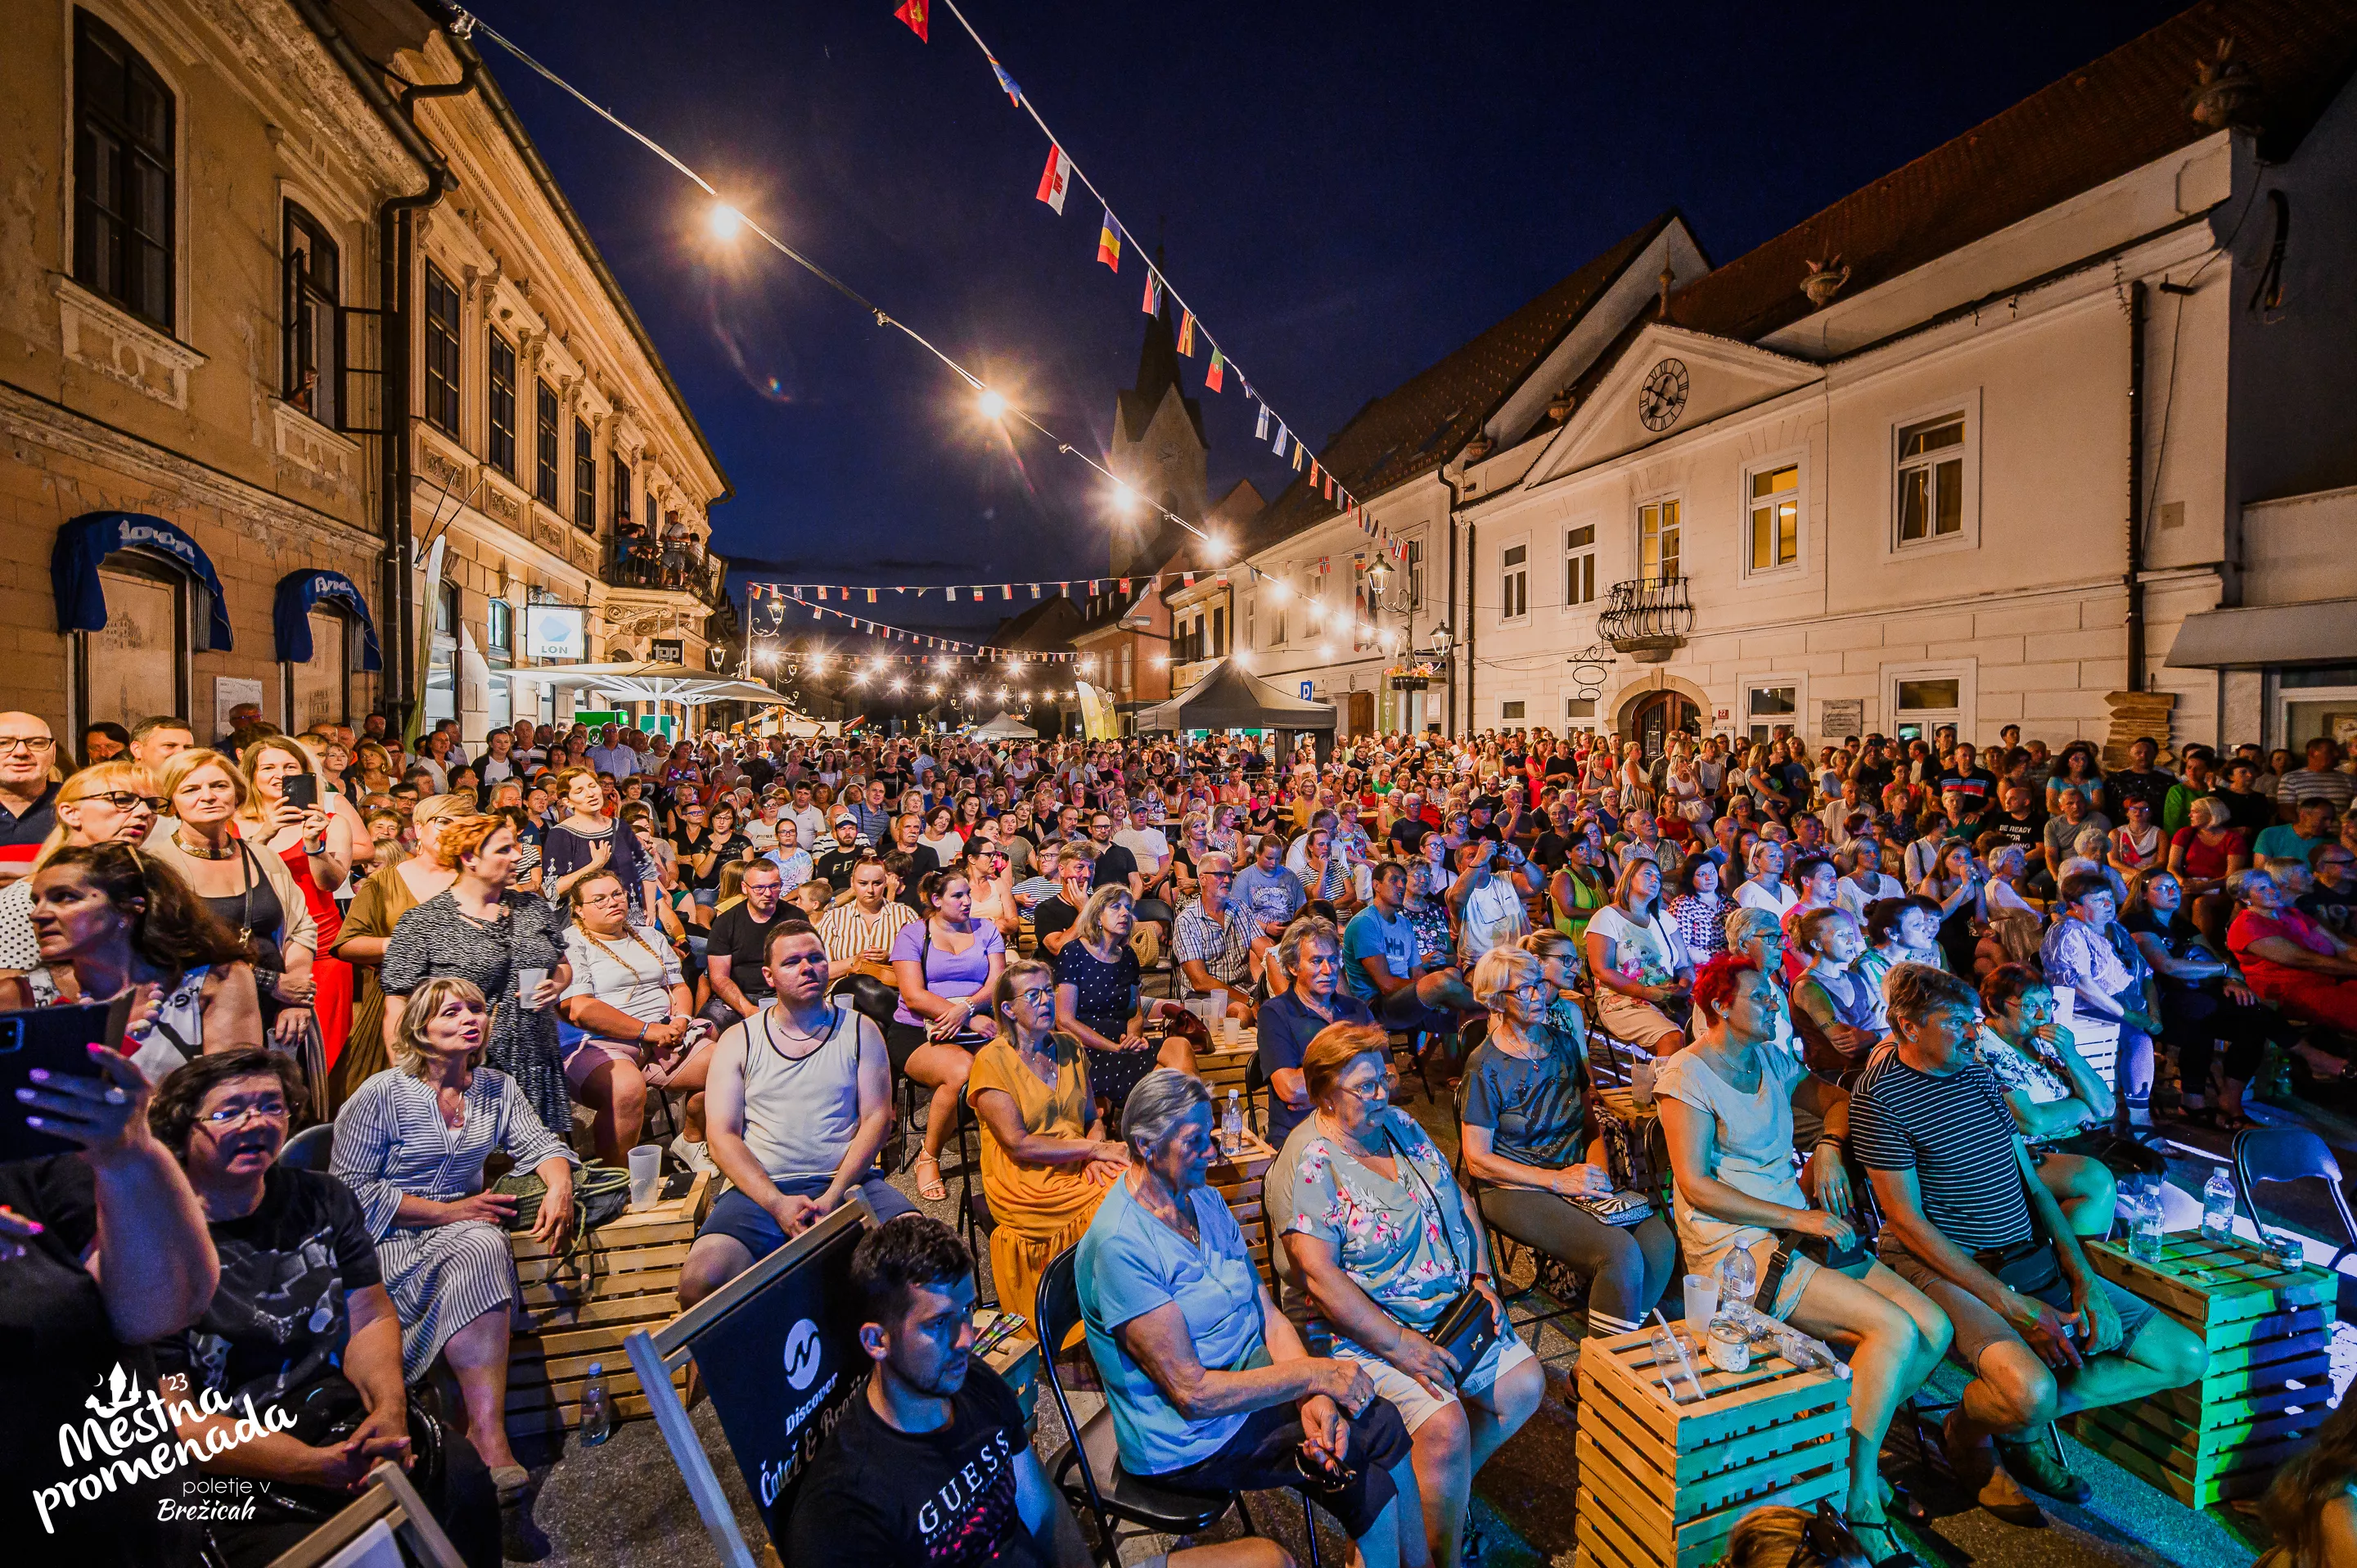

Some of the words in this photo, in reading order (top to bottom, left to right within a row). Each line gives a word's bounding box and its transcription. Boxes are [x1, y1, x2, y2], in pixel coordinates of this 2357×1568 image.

[542, 646, 568, 654] LON
[786, 1372, 838, 1436] Discover
[918, 1429, 1010, 1534] GUESS
